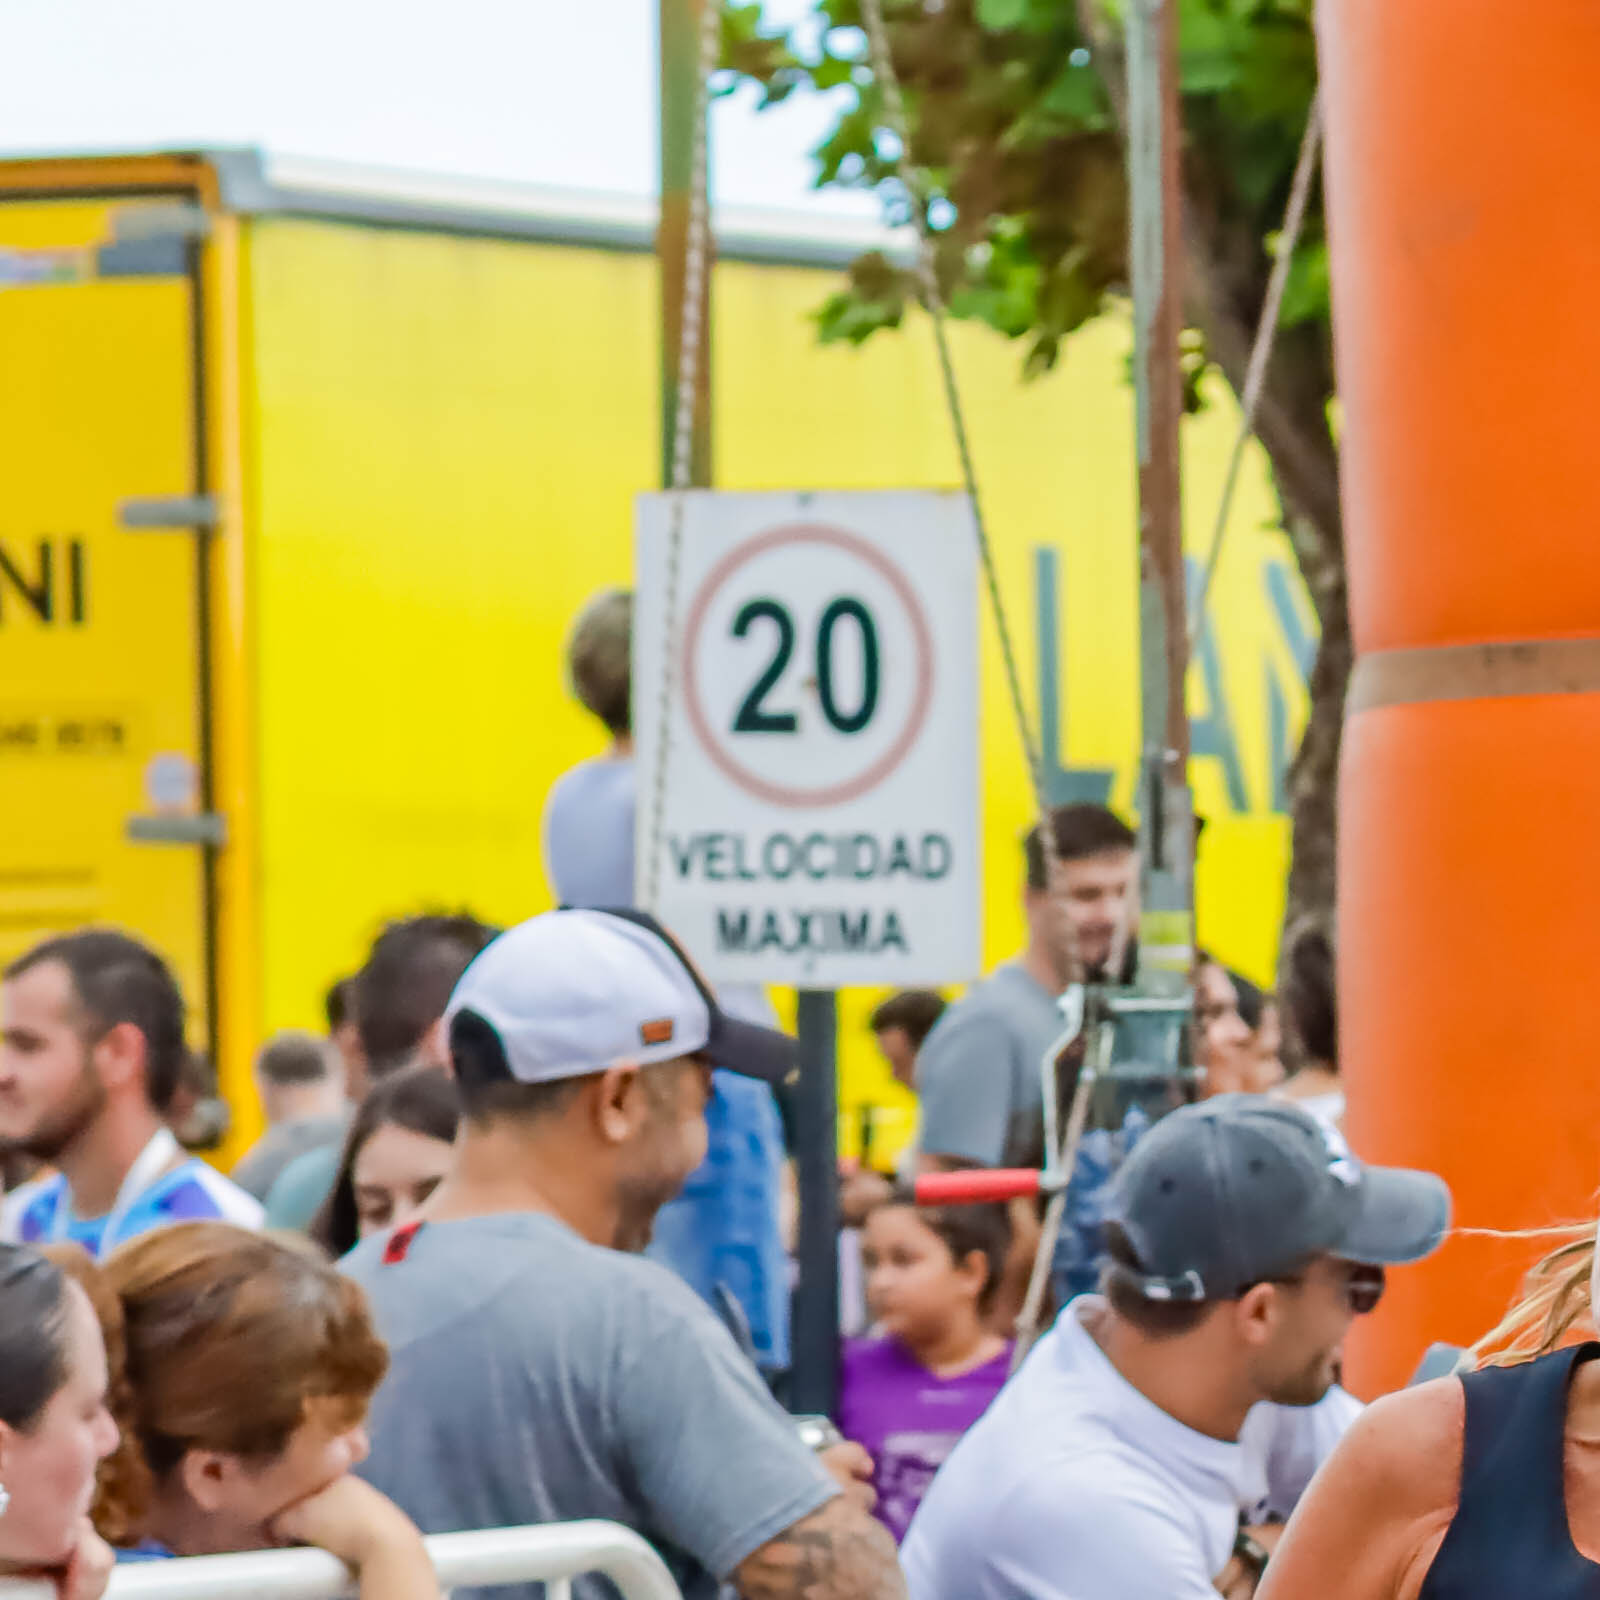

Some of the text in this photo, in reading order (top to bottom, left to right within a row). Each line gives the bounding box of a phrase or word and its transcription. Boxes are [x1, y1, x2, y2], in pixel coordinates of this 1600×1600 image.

[732, 598, 880, 734] 20
[669, 832, 953, 883] VELOCIDAD
[715, 908, 908, 956] MAXIMA
